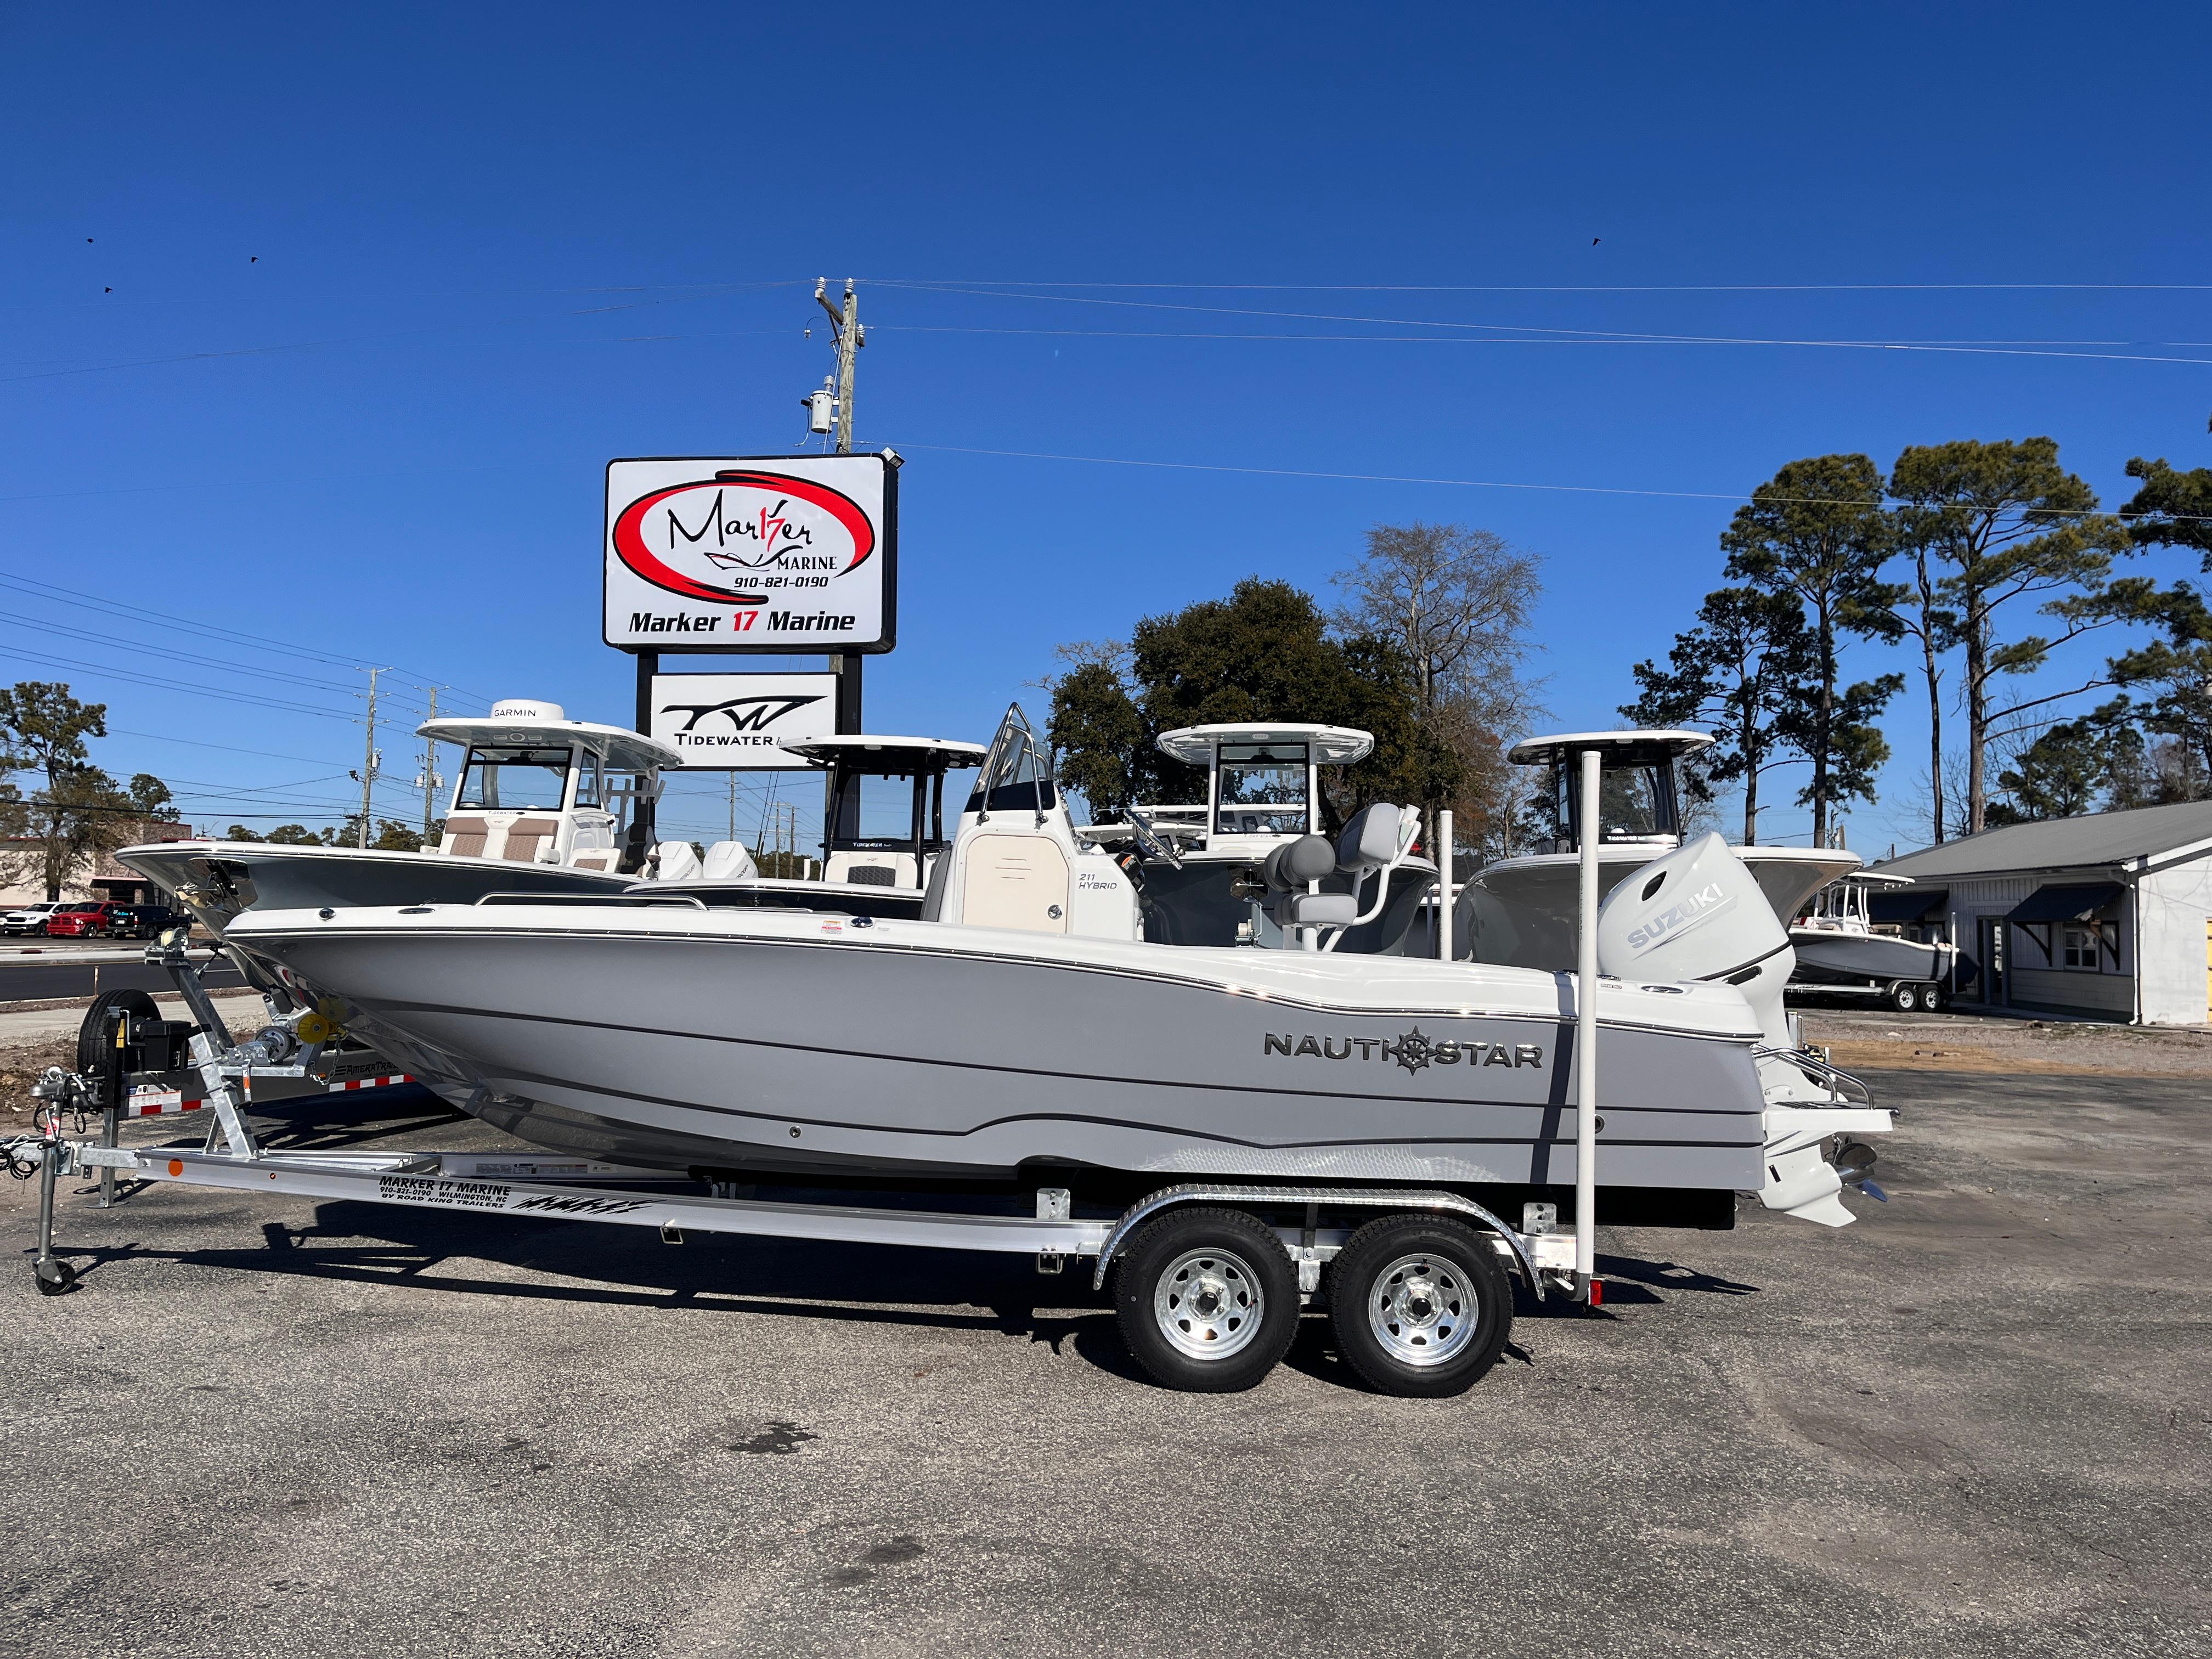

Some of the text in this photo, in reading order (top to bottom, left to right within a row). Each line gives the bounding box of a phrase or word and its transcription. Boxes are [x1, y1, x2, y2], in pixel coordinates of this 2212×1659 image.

[777, 556, 837, 571] MARINE
[734, 576, 829, 588] 910-821-0190
[629, 610, 855, 632] Marker 17 Marine
[494, 709, 536, 717] GARMIN
[674, 733, 774, 746] TIDEWATER
[1627, 882, 1724, 949] SUZUKI
[379, 1176, 511, 1196] MARKER 17 MARINE
[380, 1186, 432, 1196] 910-821-0190
[438, 1191, 493, 1202] WILMINGTON,
[456, 1199, 505, 1208] TRAILERS
